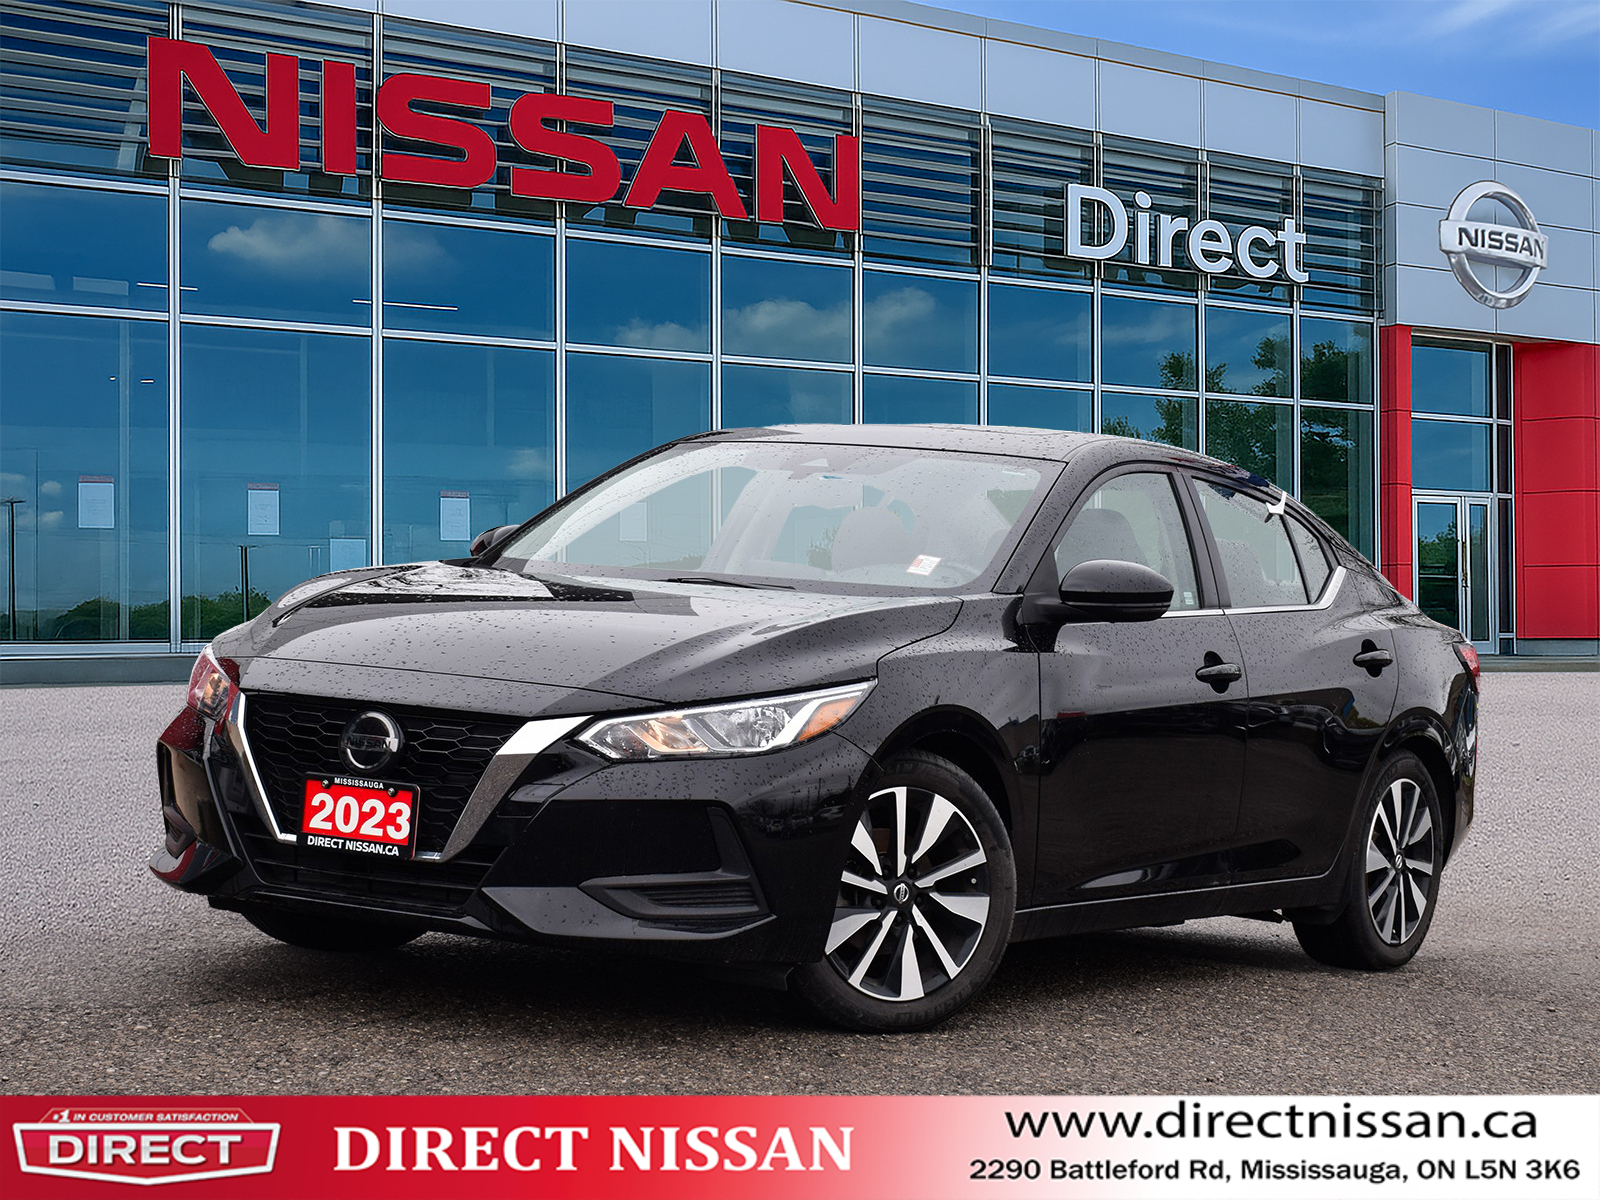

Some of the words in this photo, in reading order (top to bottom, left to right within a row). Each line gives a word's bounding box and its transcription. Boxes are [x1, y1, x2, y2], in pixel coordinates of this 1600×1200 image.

[147, 36, 861, 232] NISSAN
[1064, 183, 1309, 283] Direct
[1458, 227, 1544, 260] NISSAN
[334, 777, 384, 789] MISSISSAUGA
[309, 792, 411, 840] 2023
[307, 835, 344, 849] DIRECT
[345, 841, 399, 856] NISSAN.CA
